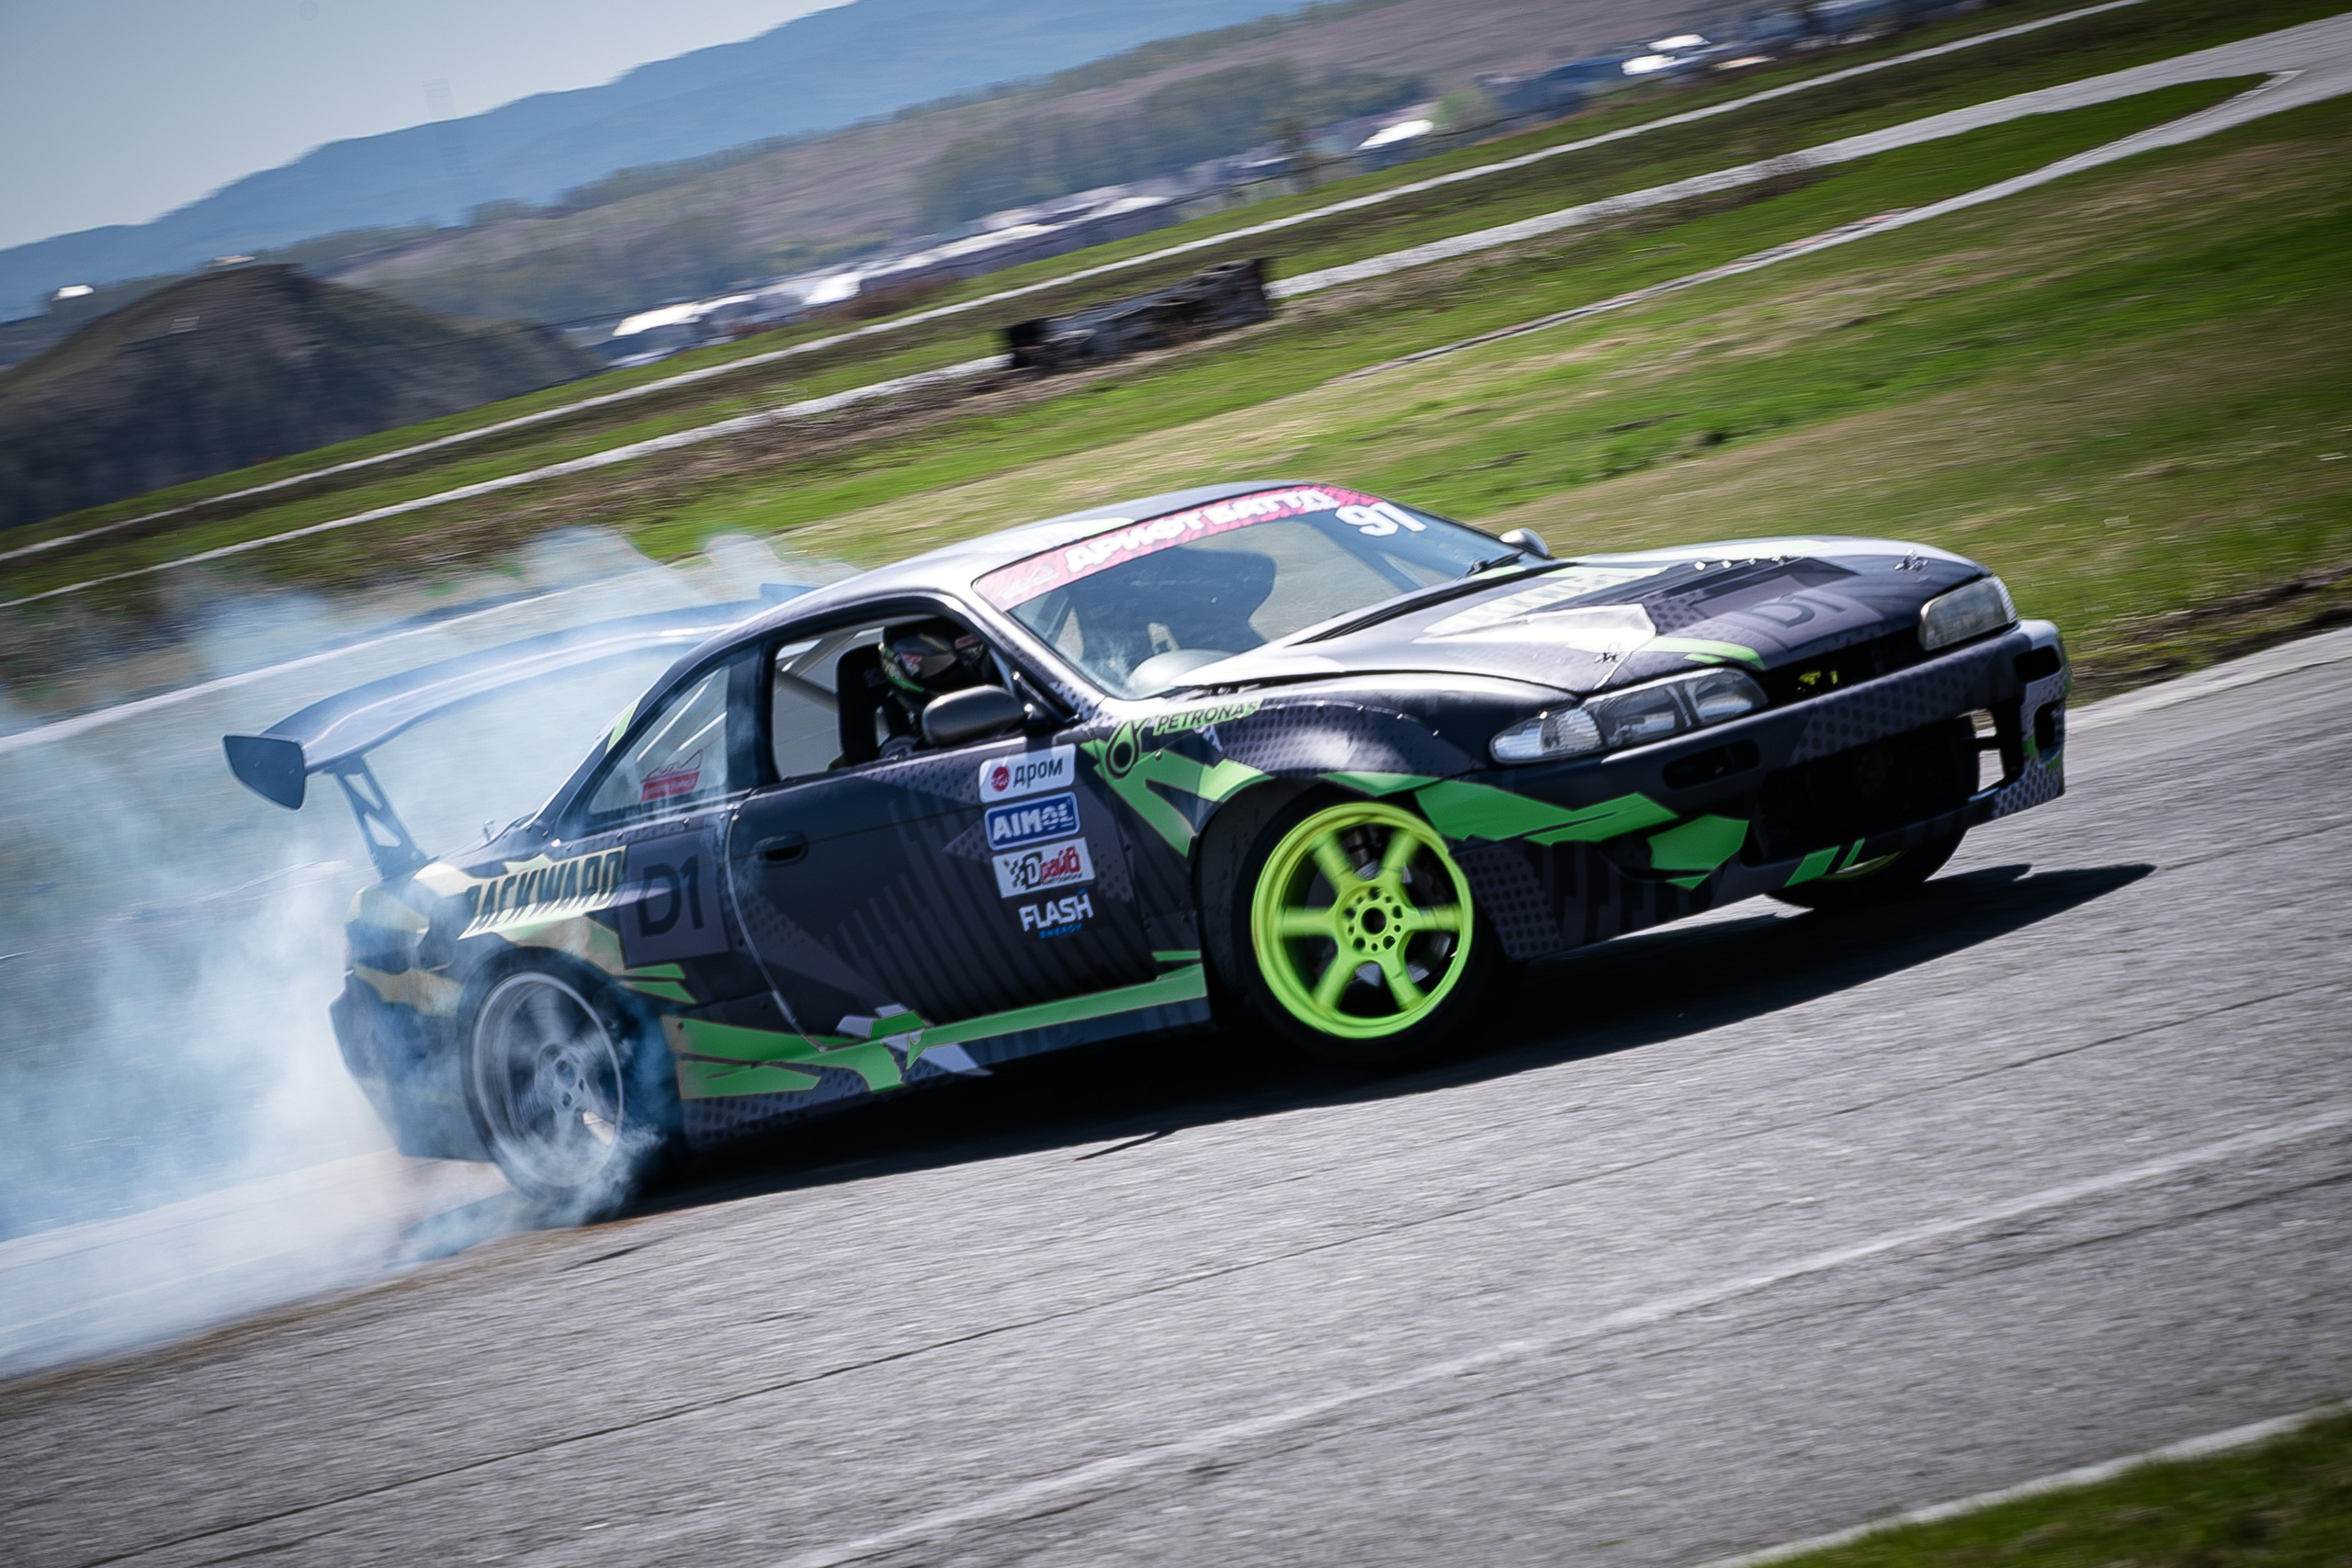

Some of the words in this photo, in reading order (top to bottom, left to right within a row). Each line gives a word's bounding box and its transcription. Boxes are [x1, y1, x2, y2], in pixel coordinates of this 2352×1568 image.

[1335, 502, 1427, 536] 91
[1158, 701, 1258, 729] PETRONAS
[993, 803, 1074, 840] AIMOL
[637, 856, 704, 937] D1
[1018, 893, 1093, 931] FLASH
